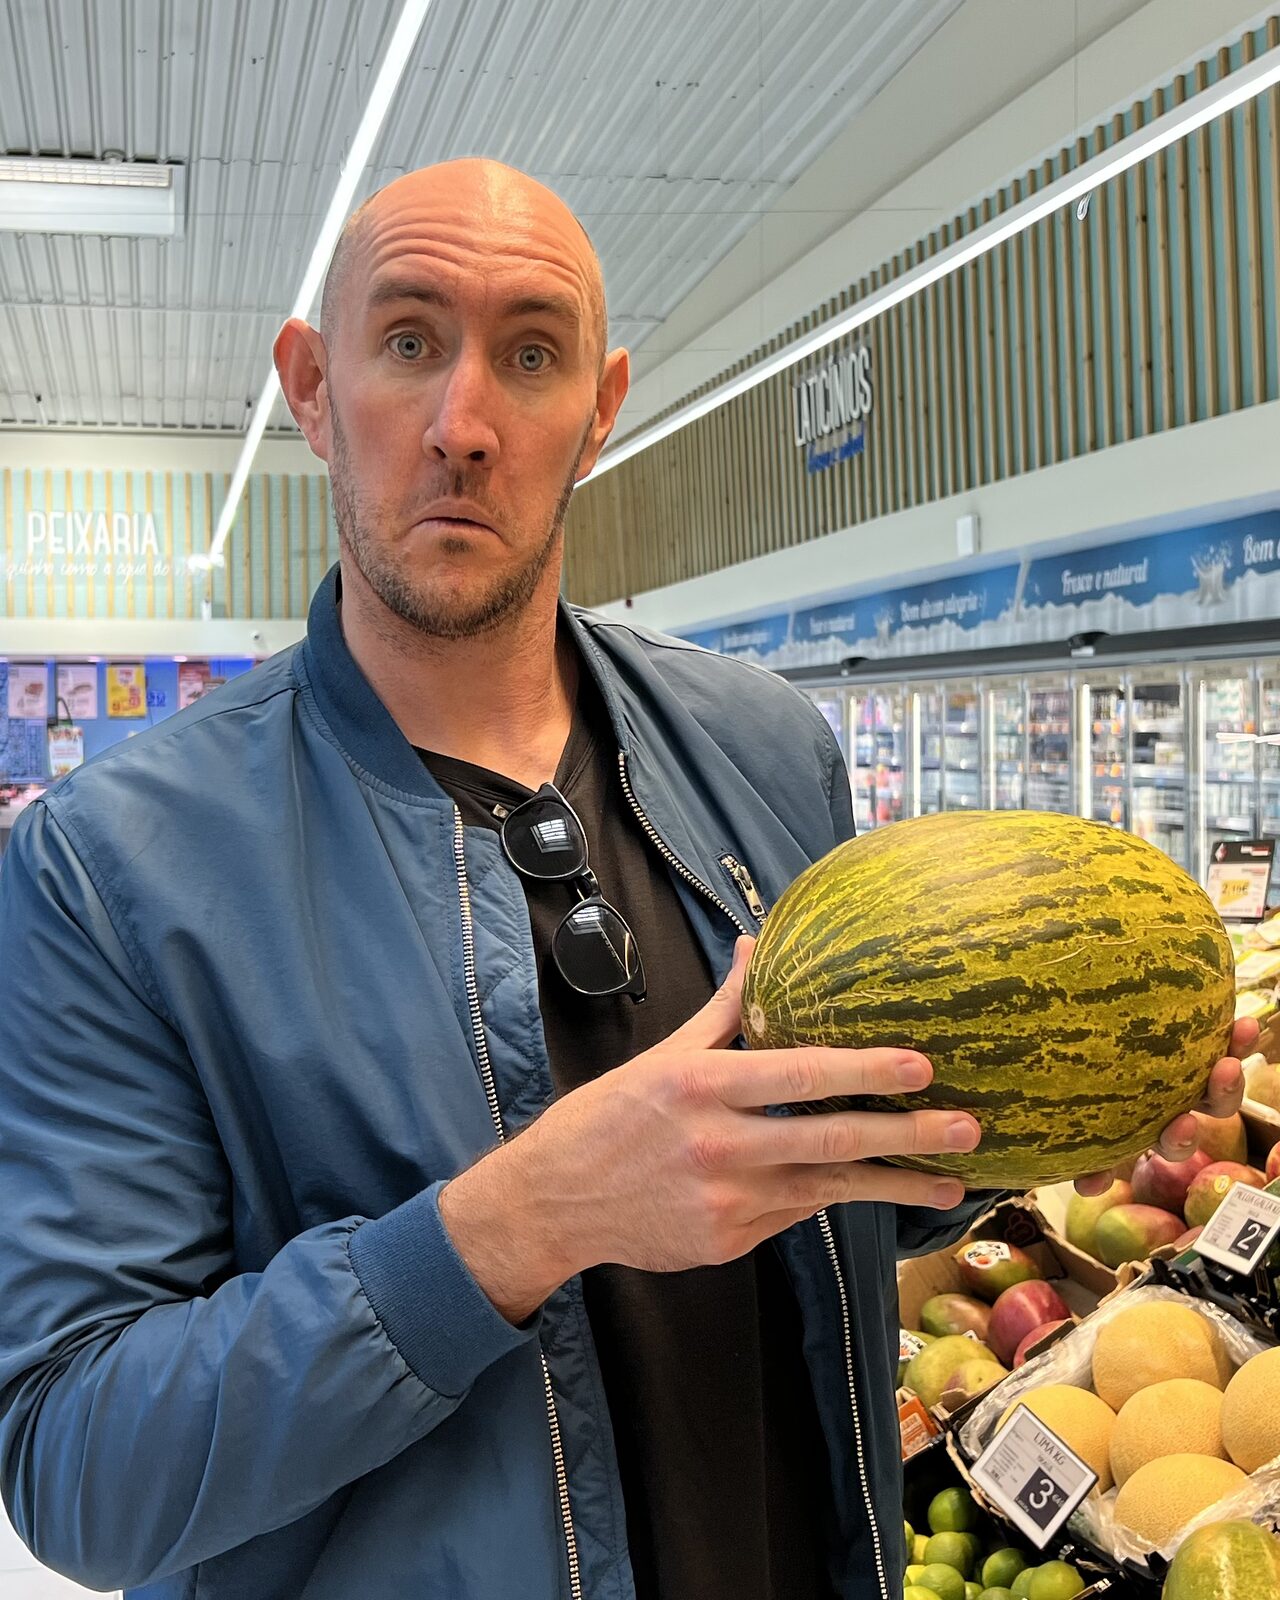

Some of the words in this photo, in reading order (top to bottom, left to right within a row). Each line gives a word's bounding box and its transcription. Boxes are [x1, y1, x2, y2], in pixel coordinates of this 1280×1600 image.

[27, 511, 159, 555] PEIXARIA
[1243, 534, 1274, 565] Bom
[1103, 556, 1148, 589] natural
[1237, 1223, 1260, 1250] 2
[1033, 1431, 1055, 1455] LIMA
[1053, 1450, 1066, 1466] KG
[1029, 1478, 1054, 1509] 3
